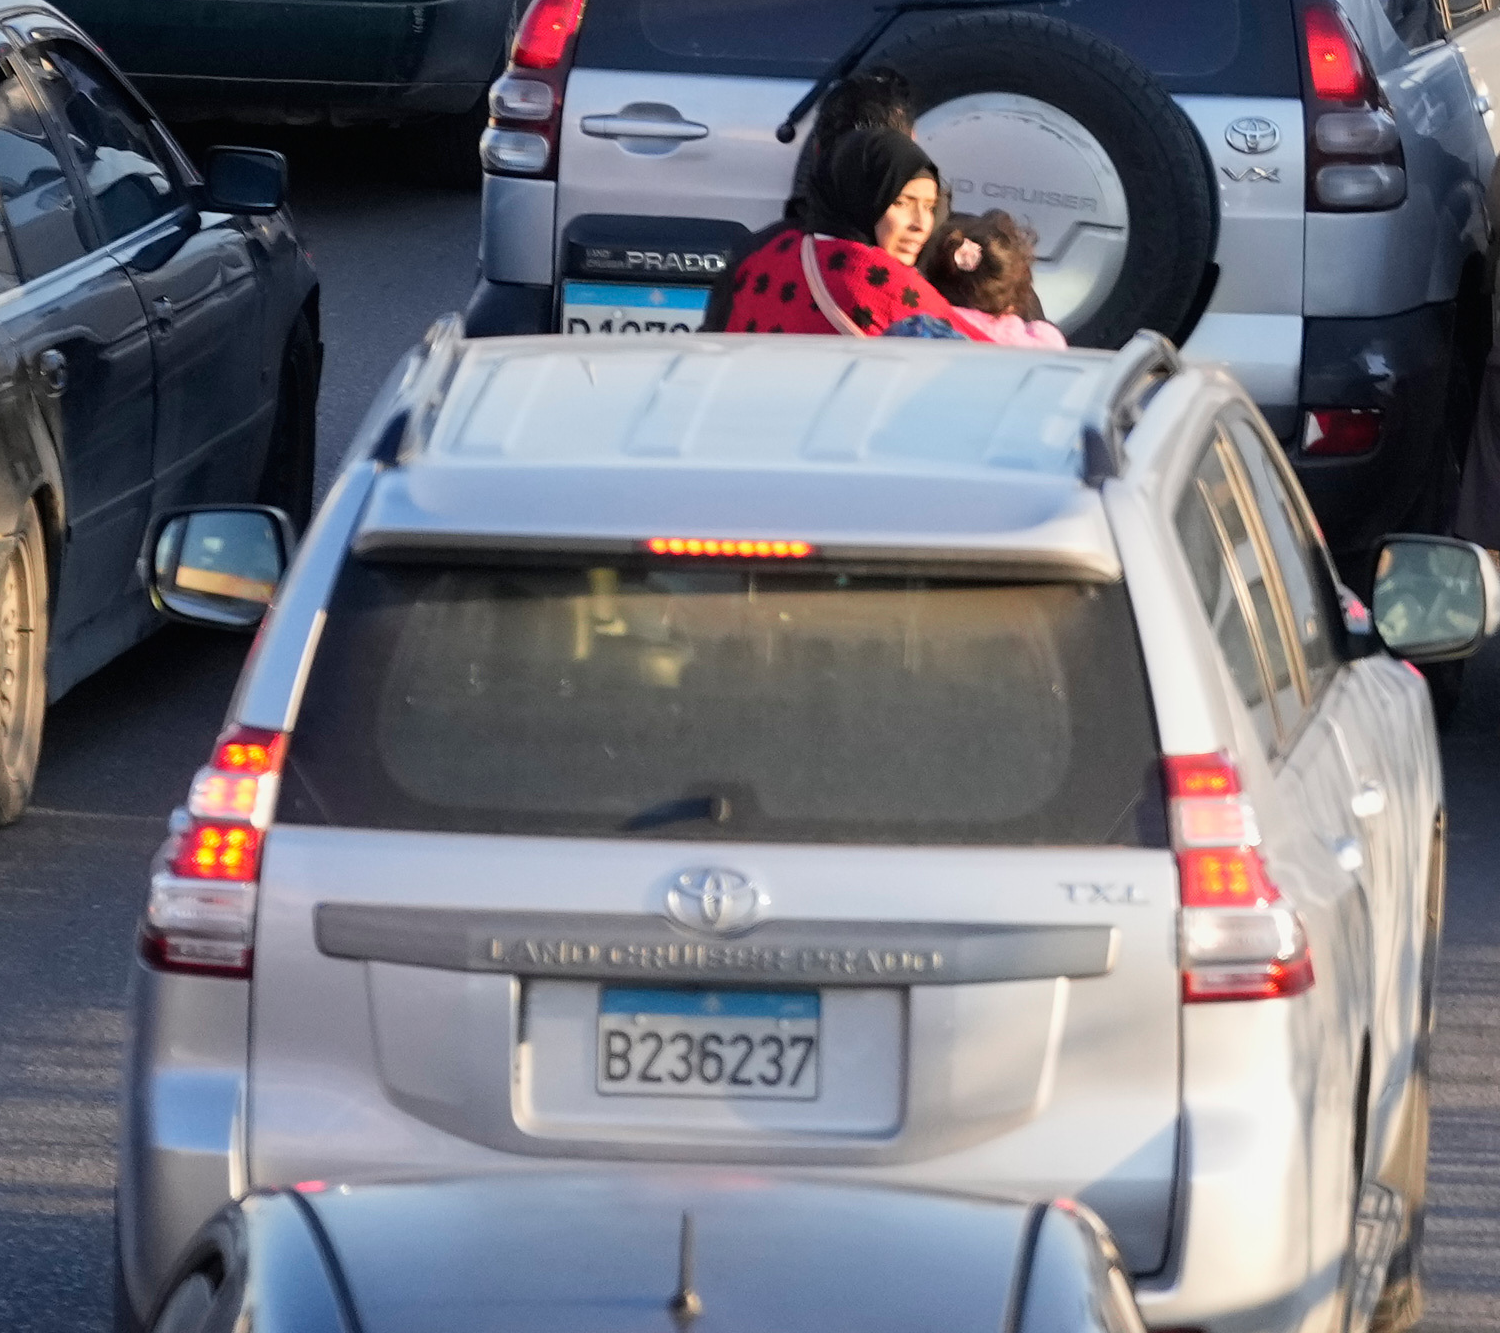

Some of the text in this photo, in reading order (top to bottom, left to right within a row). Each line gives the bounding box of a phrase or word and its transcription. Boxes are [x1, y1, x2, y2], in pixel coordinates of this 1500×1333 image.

[1221, 165, 1281, 183] VX
[981, 181, 1098, 214] CRUISER
[625, 249, 727, 274] PRADO
[604, 1029, 815, 1089] B236237
